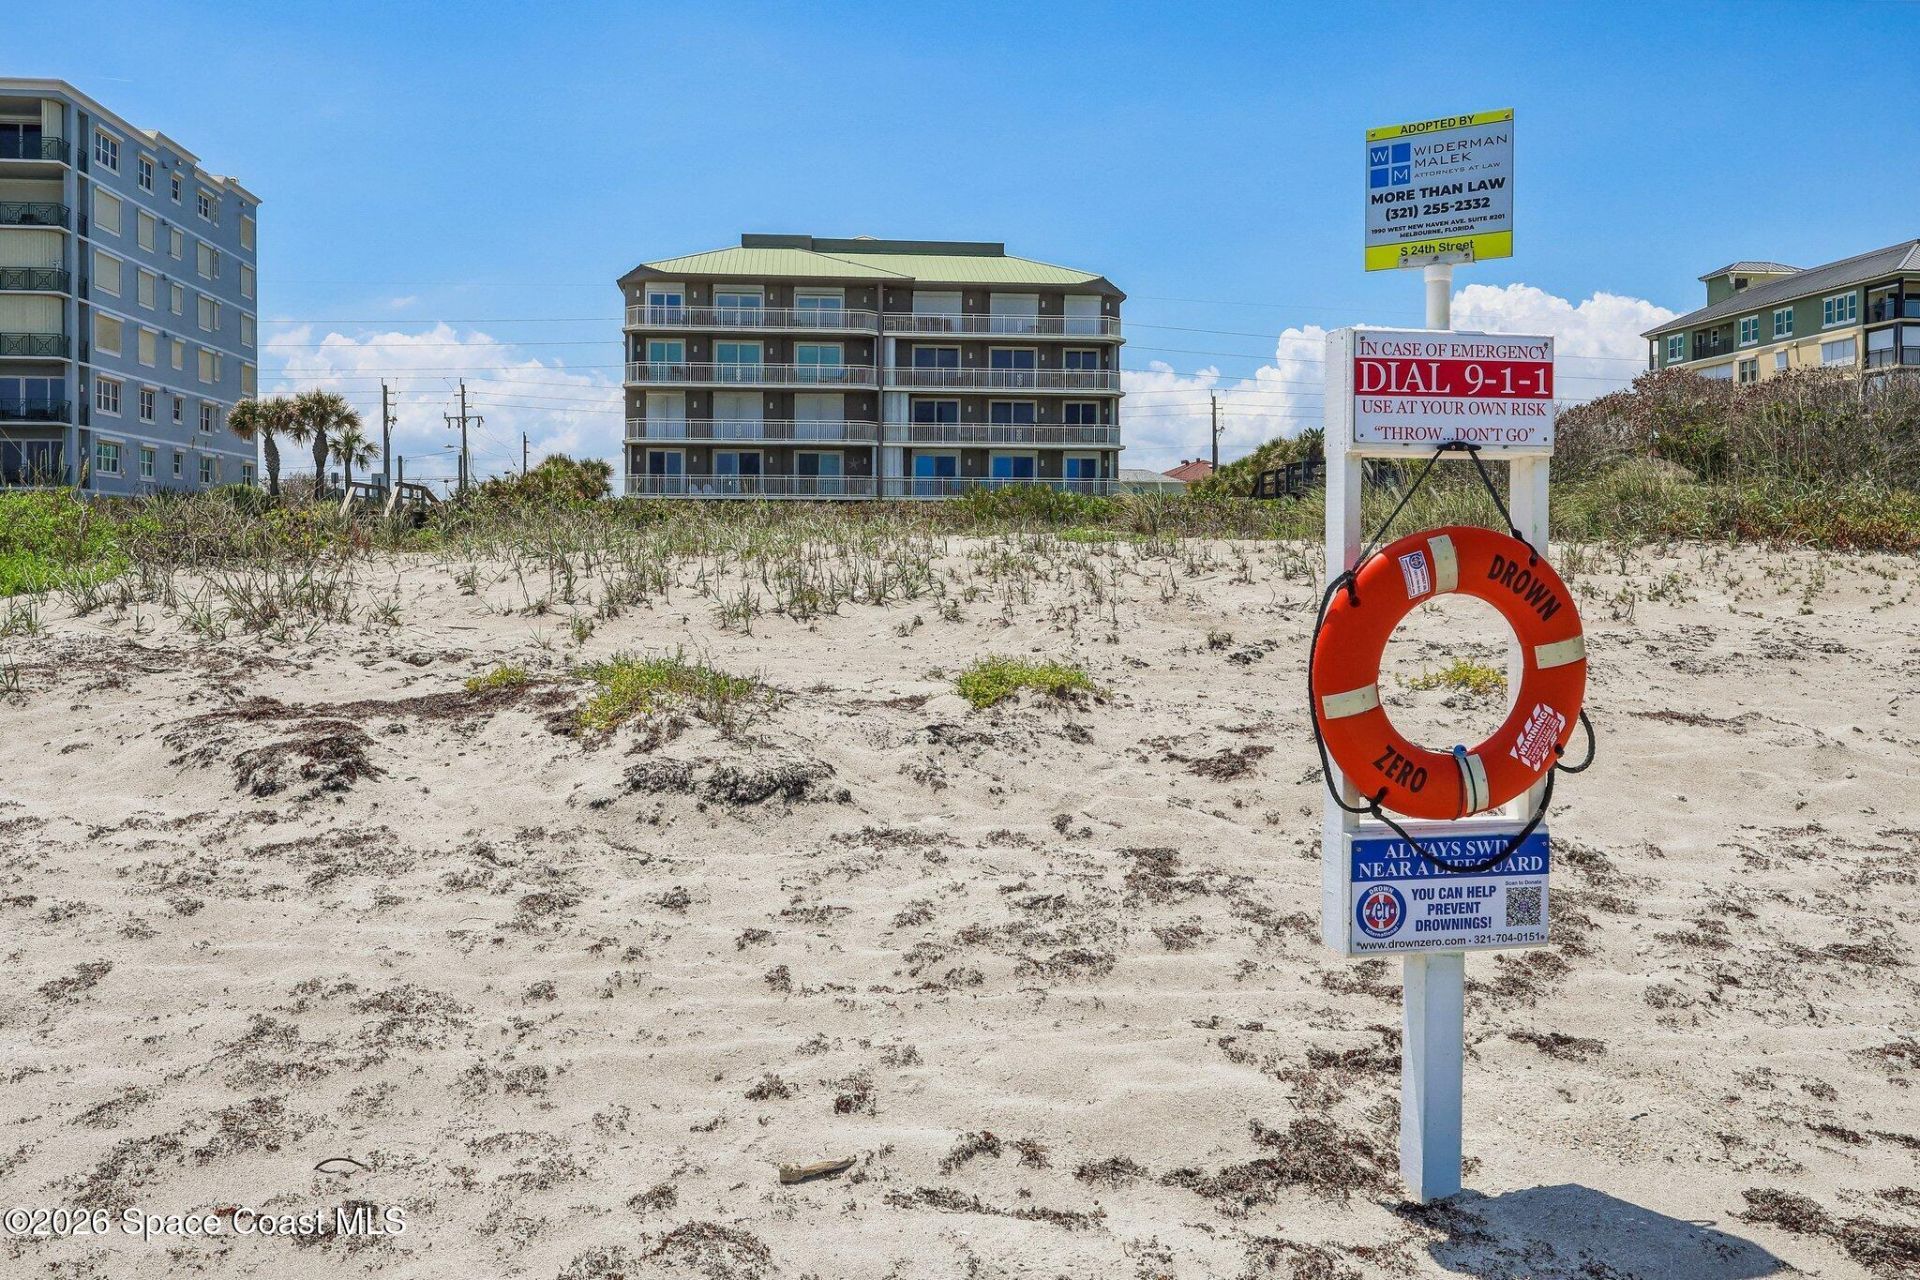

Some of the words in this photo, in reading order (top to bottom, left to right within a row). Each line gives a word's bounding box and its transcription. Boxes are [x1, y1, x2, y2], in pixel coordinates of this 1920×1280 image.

[1400, 119, 1456, 135] ADOPTED
[1459, 114, 1475, 126] BY
[1413, 133, 1508, 156] WIDERMAN
[1371, 150, 1388, 163] W
[1414, 151, 1472, 169] MALEK
[1394, 168, 1408, 182] M
[1413, 166, 1466, 179] ATTORNEYS
[1482, 161, 1502, 169] LAW
[1371, 189, 1416, 205] MORE
[1419, 182, 1464, 199] THAN
[1467, 176, 1506, 192] LAW
[1385, 204, 1419, 222] (321)
[1423, 196, 1491, 216] 255-2332
[1388, 225, 1406, 233] WEST
[1407, 223, 1424, 231] NEW
[1425, 220, 1449, 228] HAVEN
[1467, 215, 1488, 223] SUITE
[1399, 228, 1444, 238] MELBOURNE,
[1444, 224, 1475, 233] FLORIDA
[1400, 246, 1408, 257] S
[1411, 243, 1436, 256] 24th
[1438, 239, 1475, 252] Street
[1360, 341, 1378, 356] IN
[1381, 342, 1422, 357] CASE
[1425, 343, 1448, 357] OF
[1451, 344, 1549, 360] EMERGENCY
[1359, 361, 1450, 393] DIAL
[1464, 364, 1549, 395] 9-1-1
[1361, 399, 1393, 414] USE
[1396, 400, 1418, 414] AT
[1420, 400, 1464, 415] YOUR
[1468, 401, 1507, 416] OWN
[1511, 402, 1547, 416] RISK
[1487, 555, 1562, 622] DROWN
[1519, 711, 1548, 756] WARNING
[1372, 745, 1428, 793] ZERO
[1384, 841, 1461, 859] ALWAYS
[1358, 861, 1413, 878] NEAR
[1416, 860, 1429, 876] A
[1369, 886, 1395, 895] DROWN
[1411, 887, 1435, 901] YOU
[1438, 886, 1463, 900] CAN
[1466, 885, 1497, 899] HELP
[1427, 901, 1481, 916] PREVENT
[1415, 916, 1492, 932] DROWNINGS!
[1359, 936, 1466, 951] www.drownzero.com
[1474, 932, 1540, 944] 321-704-0151
